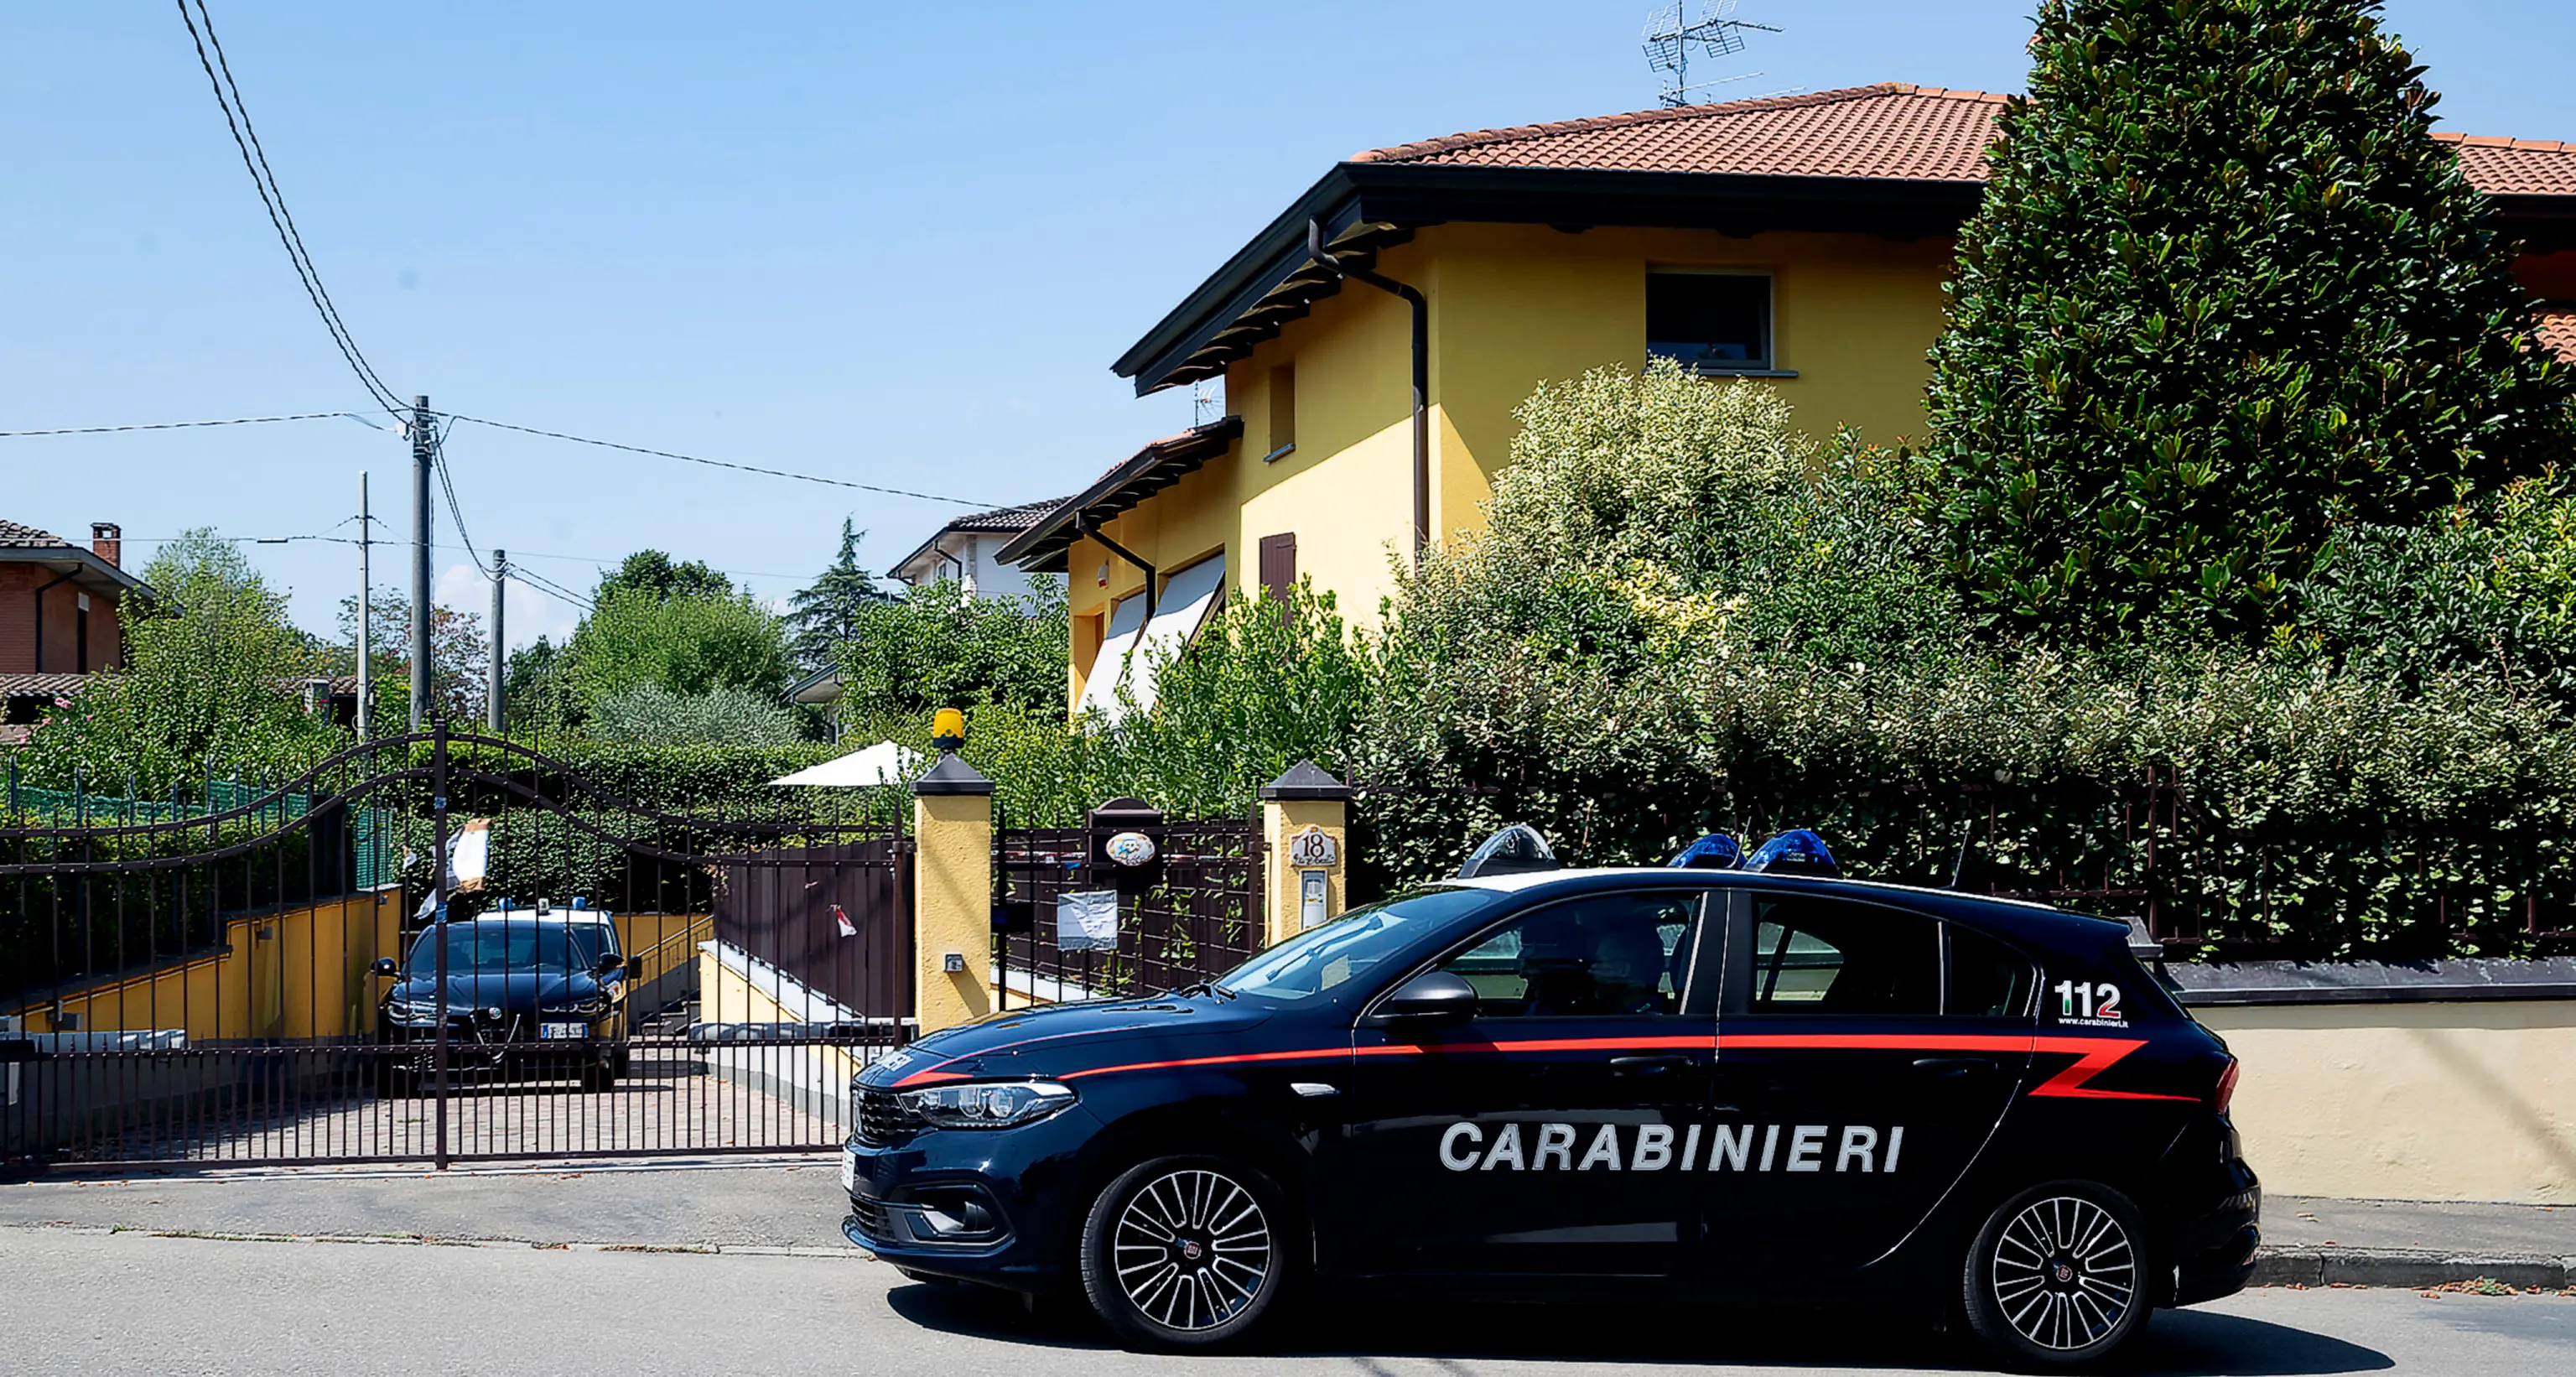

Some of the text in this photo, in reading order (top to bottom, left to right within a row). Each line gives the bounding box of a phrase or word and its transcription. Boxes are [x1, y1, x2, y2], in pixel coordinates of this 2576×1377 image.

[1302, 834, 1325, 857] 18
[2054, 980, 2122, 1019] 112
[2058, 1017, 2129, 1029] www.carabinieri.it
[1439, 1121, 1904, 1172] CARABINIERI
